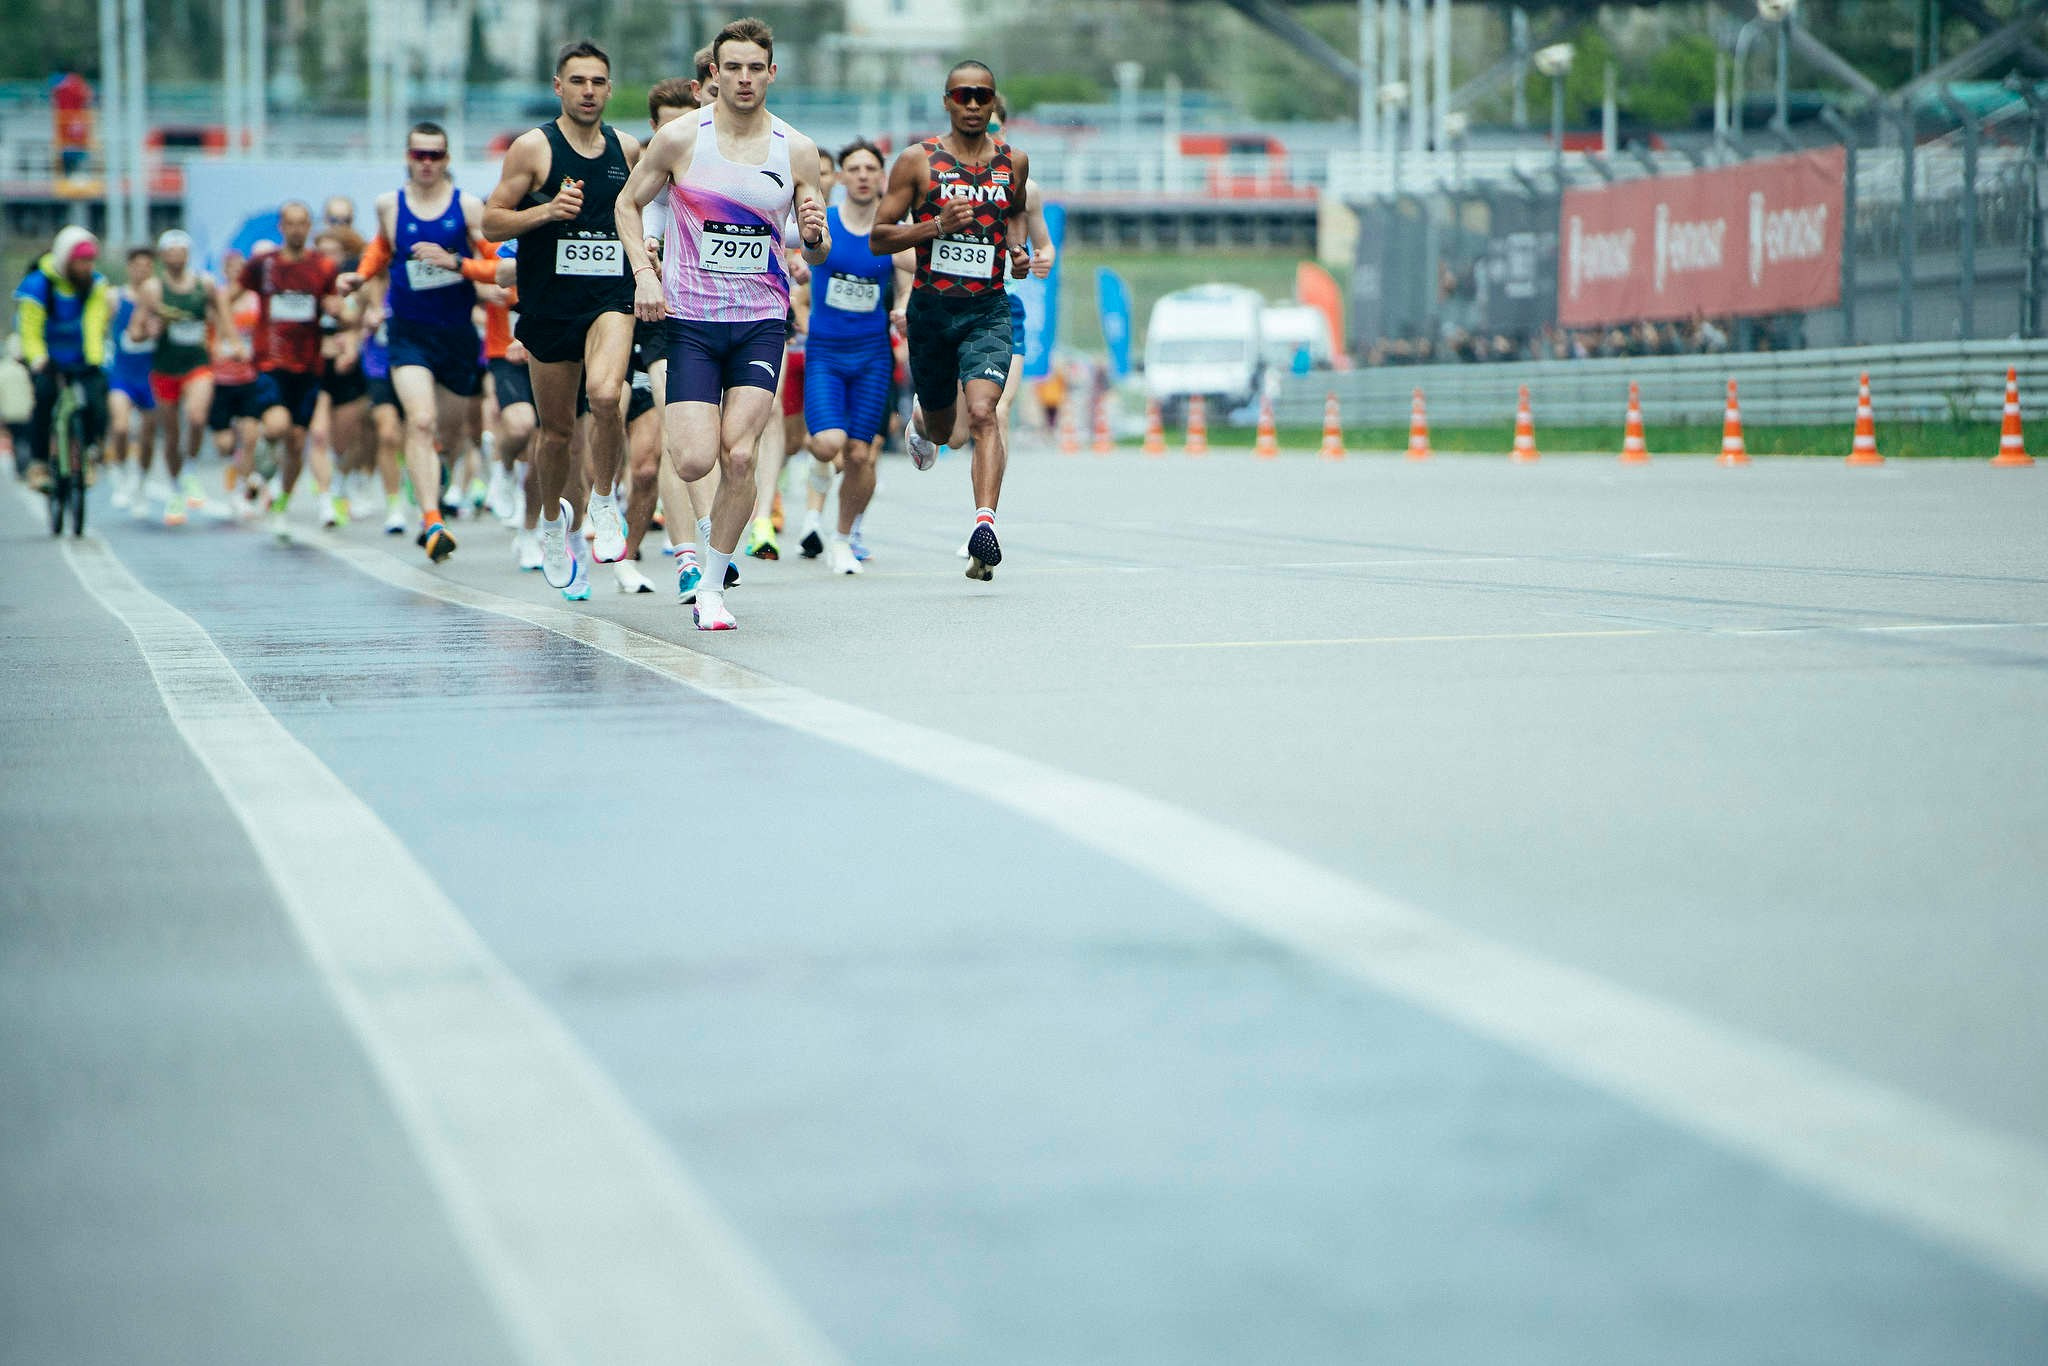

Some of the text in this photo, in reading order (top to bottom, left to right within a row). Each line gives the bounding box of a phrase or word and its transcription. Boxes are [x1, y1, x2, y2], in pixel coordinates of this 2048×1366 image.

[940, 184, 1007, 202] KENYA
[565, 244, 616, 261] 6362
[711, 238, 763, 259] 7970
[939, 244, 987, 264] 6338
